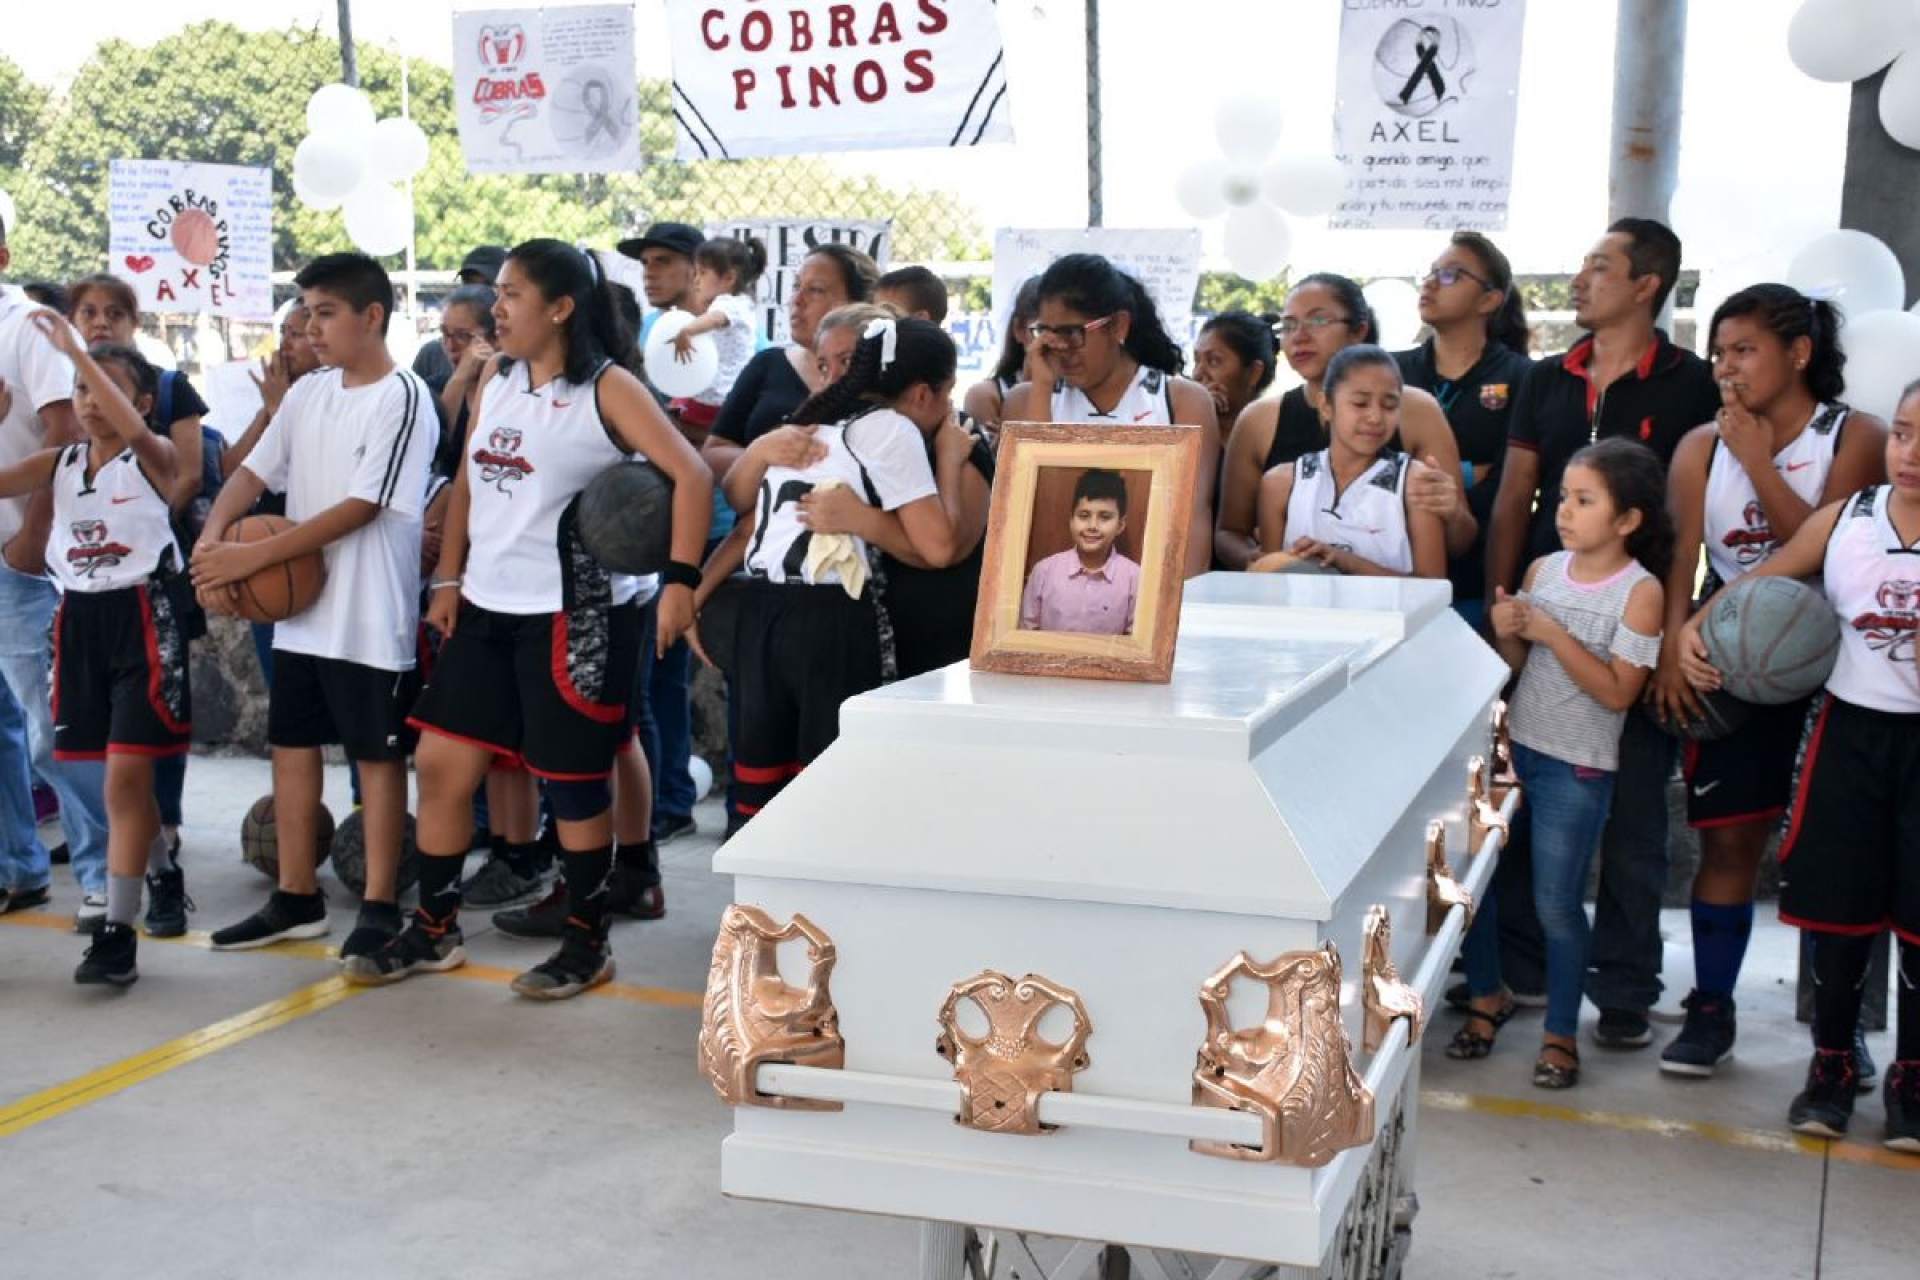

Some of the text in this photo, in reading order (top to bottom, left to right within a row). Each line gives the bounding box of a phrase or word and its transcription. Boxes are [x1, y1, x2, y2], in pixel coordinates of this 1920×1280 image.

[701, 0, 948, 51] COBRAS
[473, 73, 546, 104] COBRAS
[732, 50, 934, 110] PINOS
[1370, 121, 1459, 143] AXEL
[147, 189, 217, 239] COBRAS
[157, 268, 236, 307] AXEL
